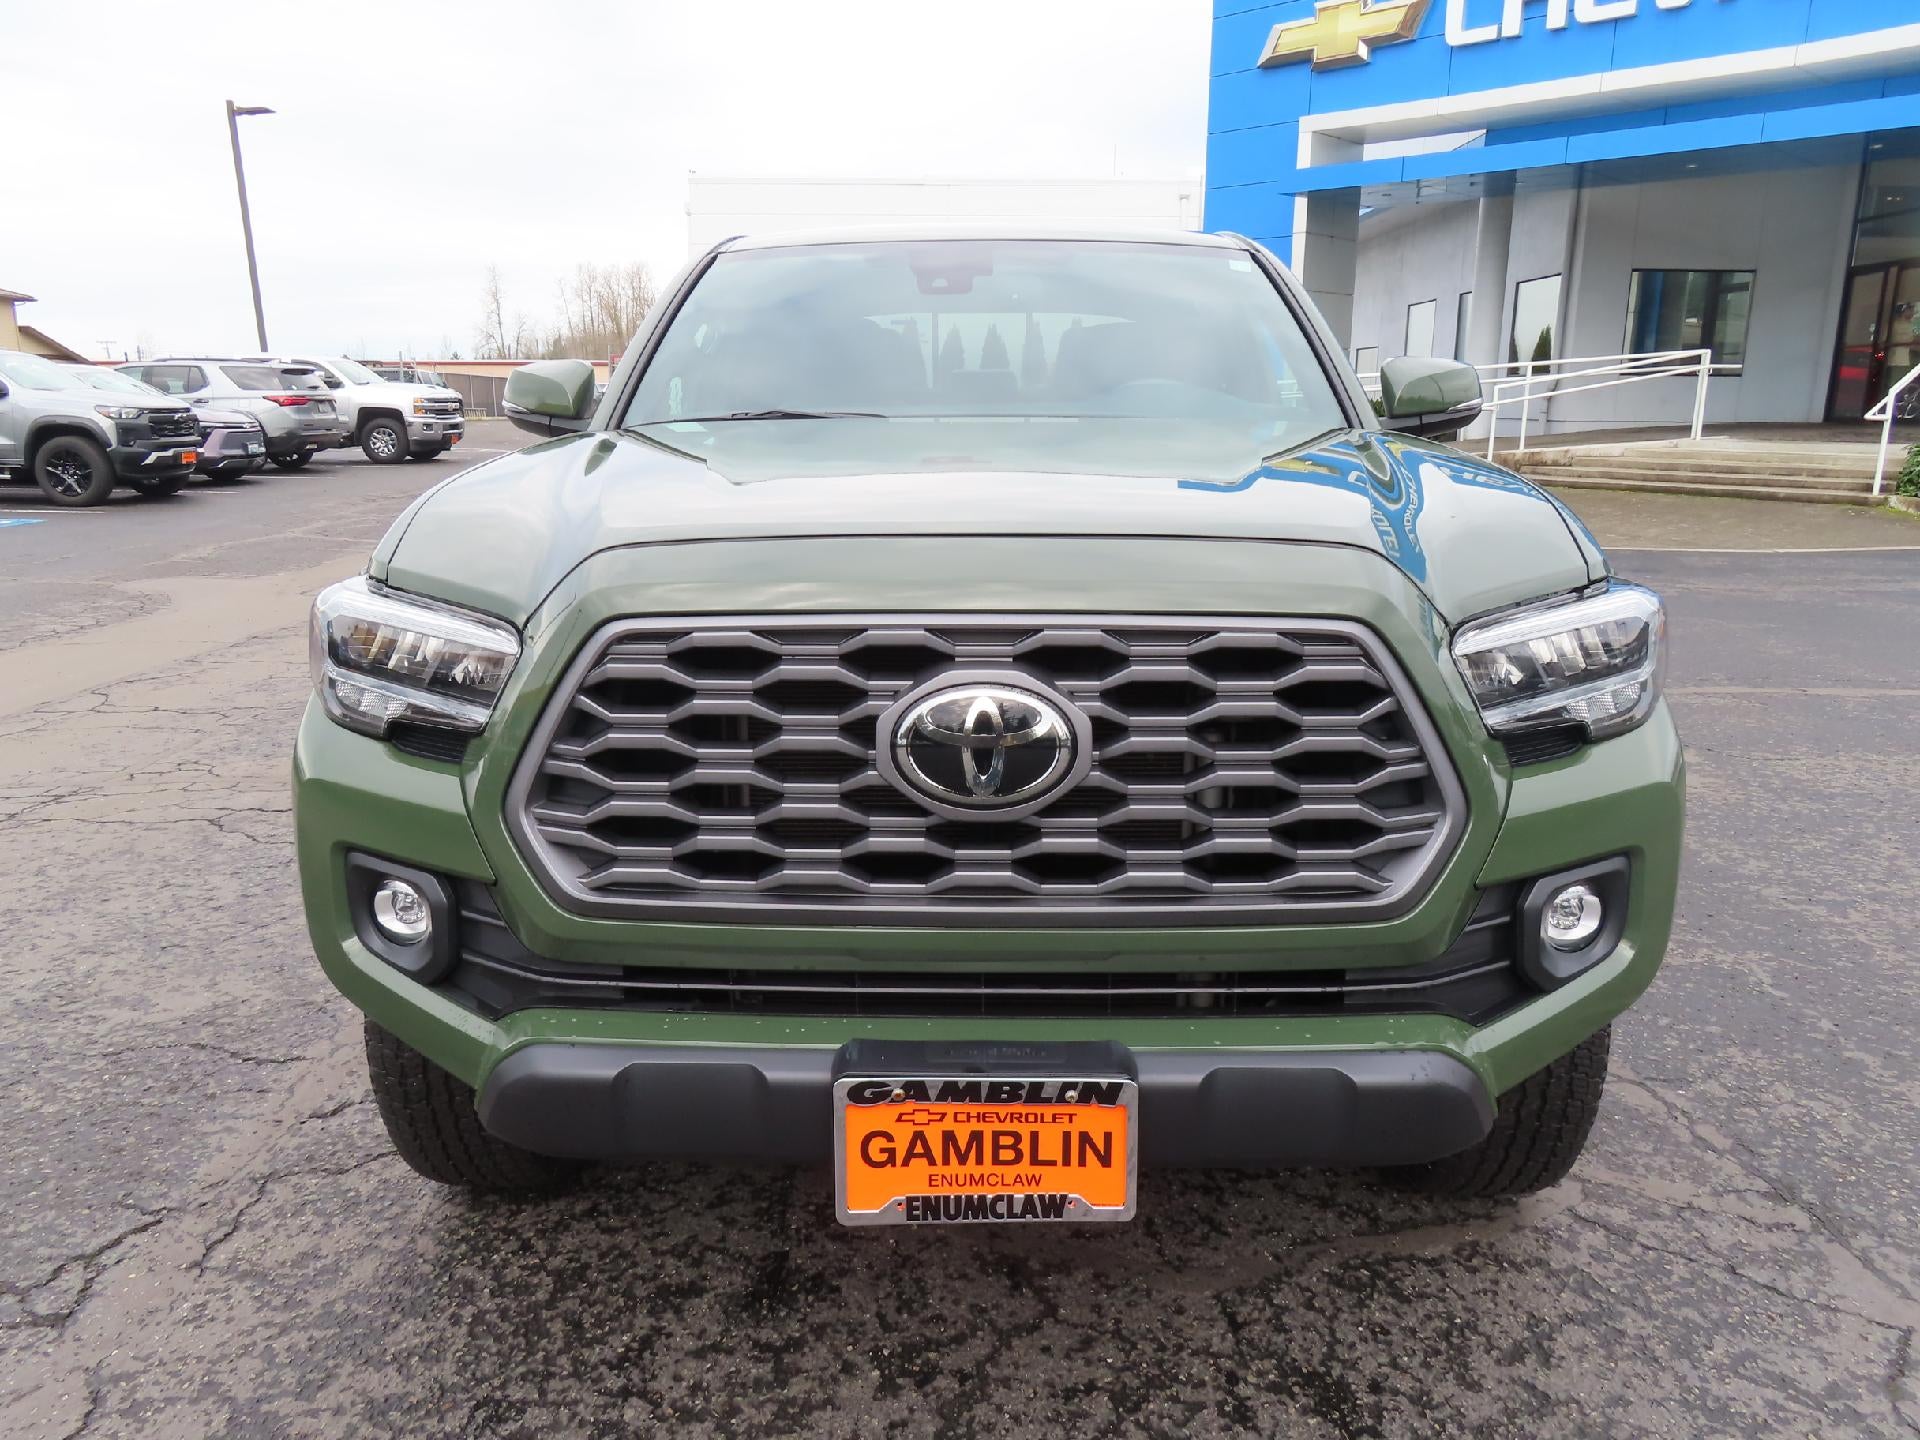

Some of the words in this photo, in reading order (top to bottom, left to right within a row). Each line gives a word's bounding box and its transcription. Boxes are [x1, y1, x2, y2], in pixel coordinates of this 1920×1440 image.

[847, 1081, 1123, 1105] GAMBLIN
[954, 1112, 1077, 1123] CHEVROLET
[861, 1130, 1112, 1168] GAMBLIN
[928, 1173, 1042, 1187] ENUMCLAW
[905, 1194, 1069, 1221] ENUMCLAW
